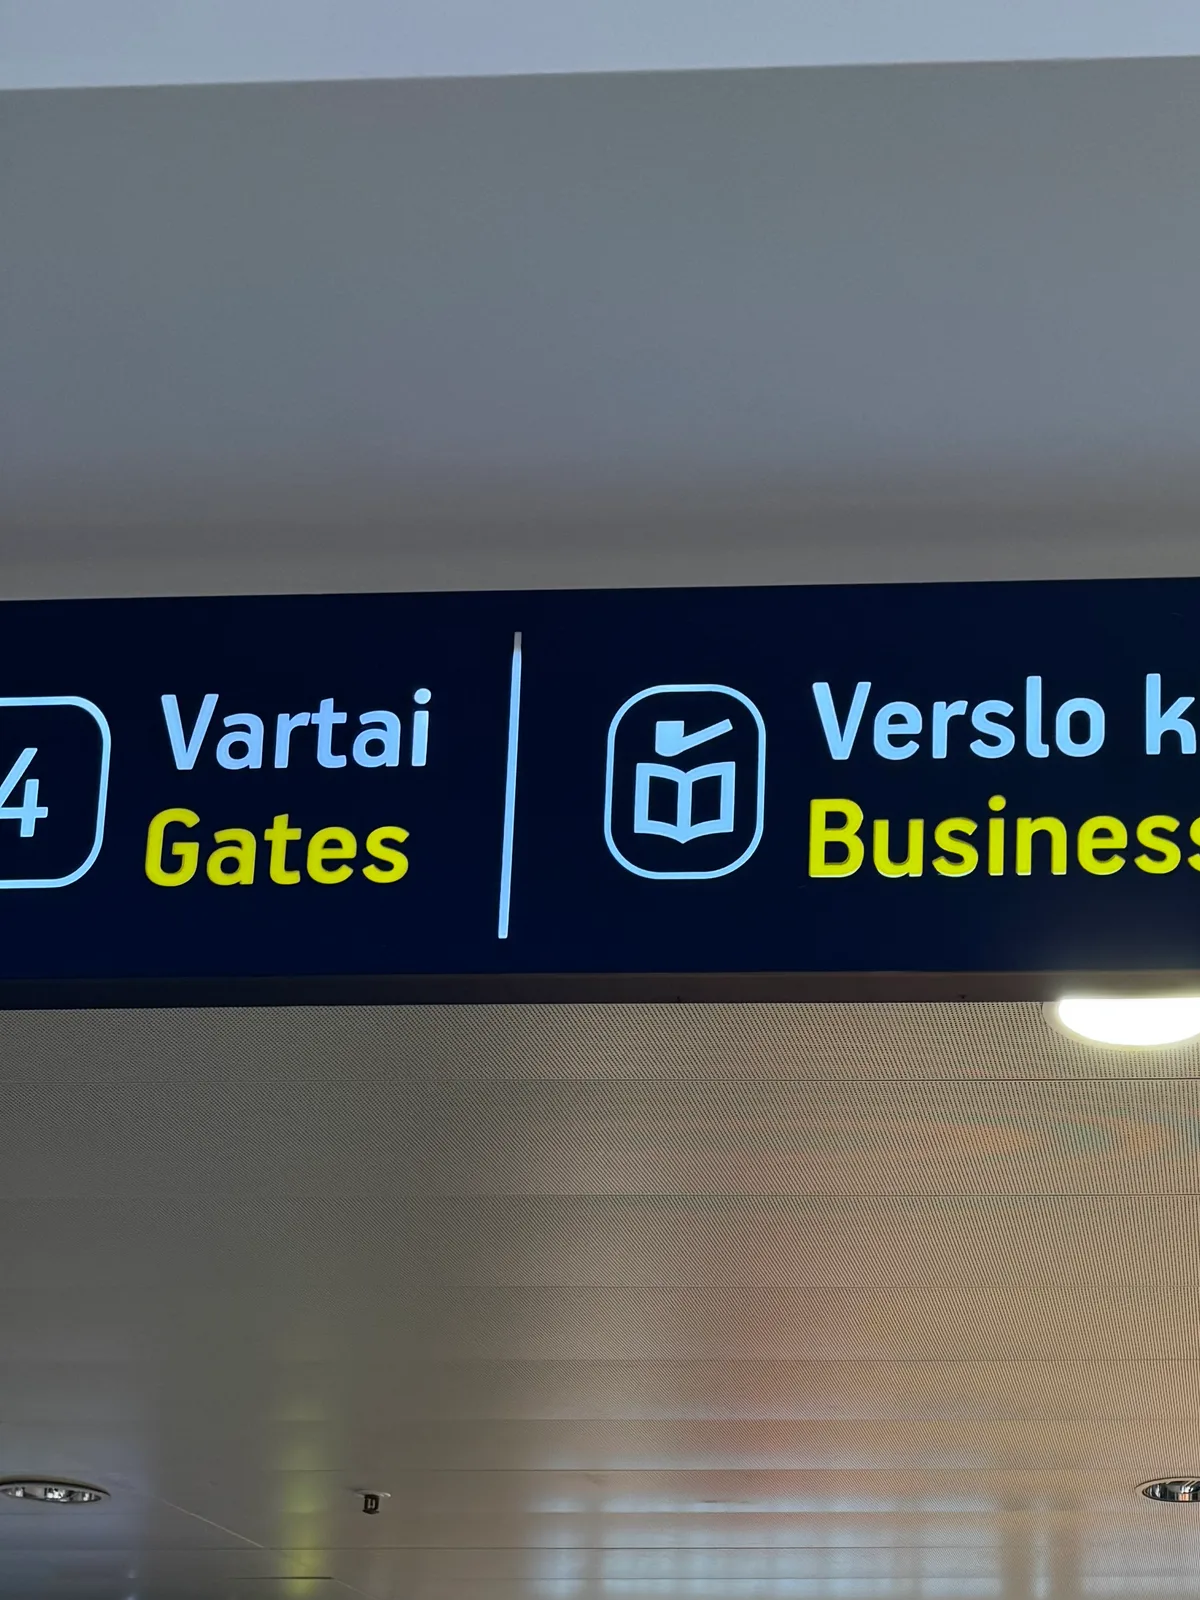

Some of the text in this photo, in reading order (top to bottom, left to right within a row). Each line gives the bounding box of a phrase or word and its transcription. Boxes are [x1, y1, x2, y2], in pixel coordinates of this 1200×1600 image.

[161, 688, 431, 770] Vartai
[812, 676, 1106, 760] Verslo
[145, 808, 410, 887] Gates
